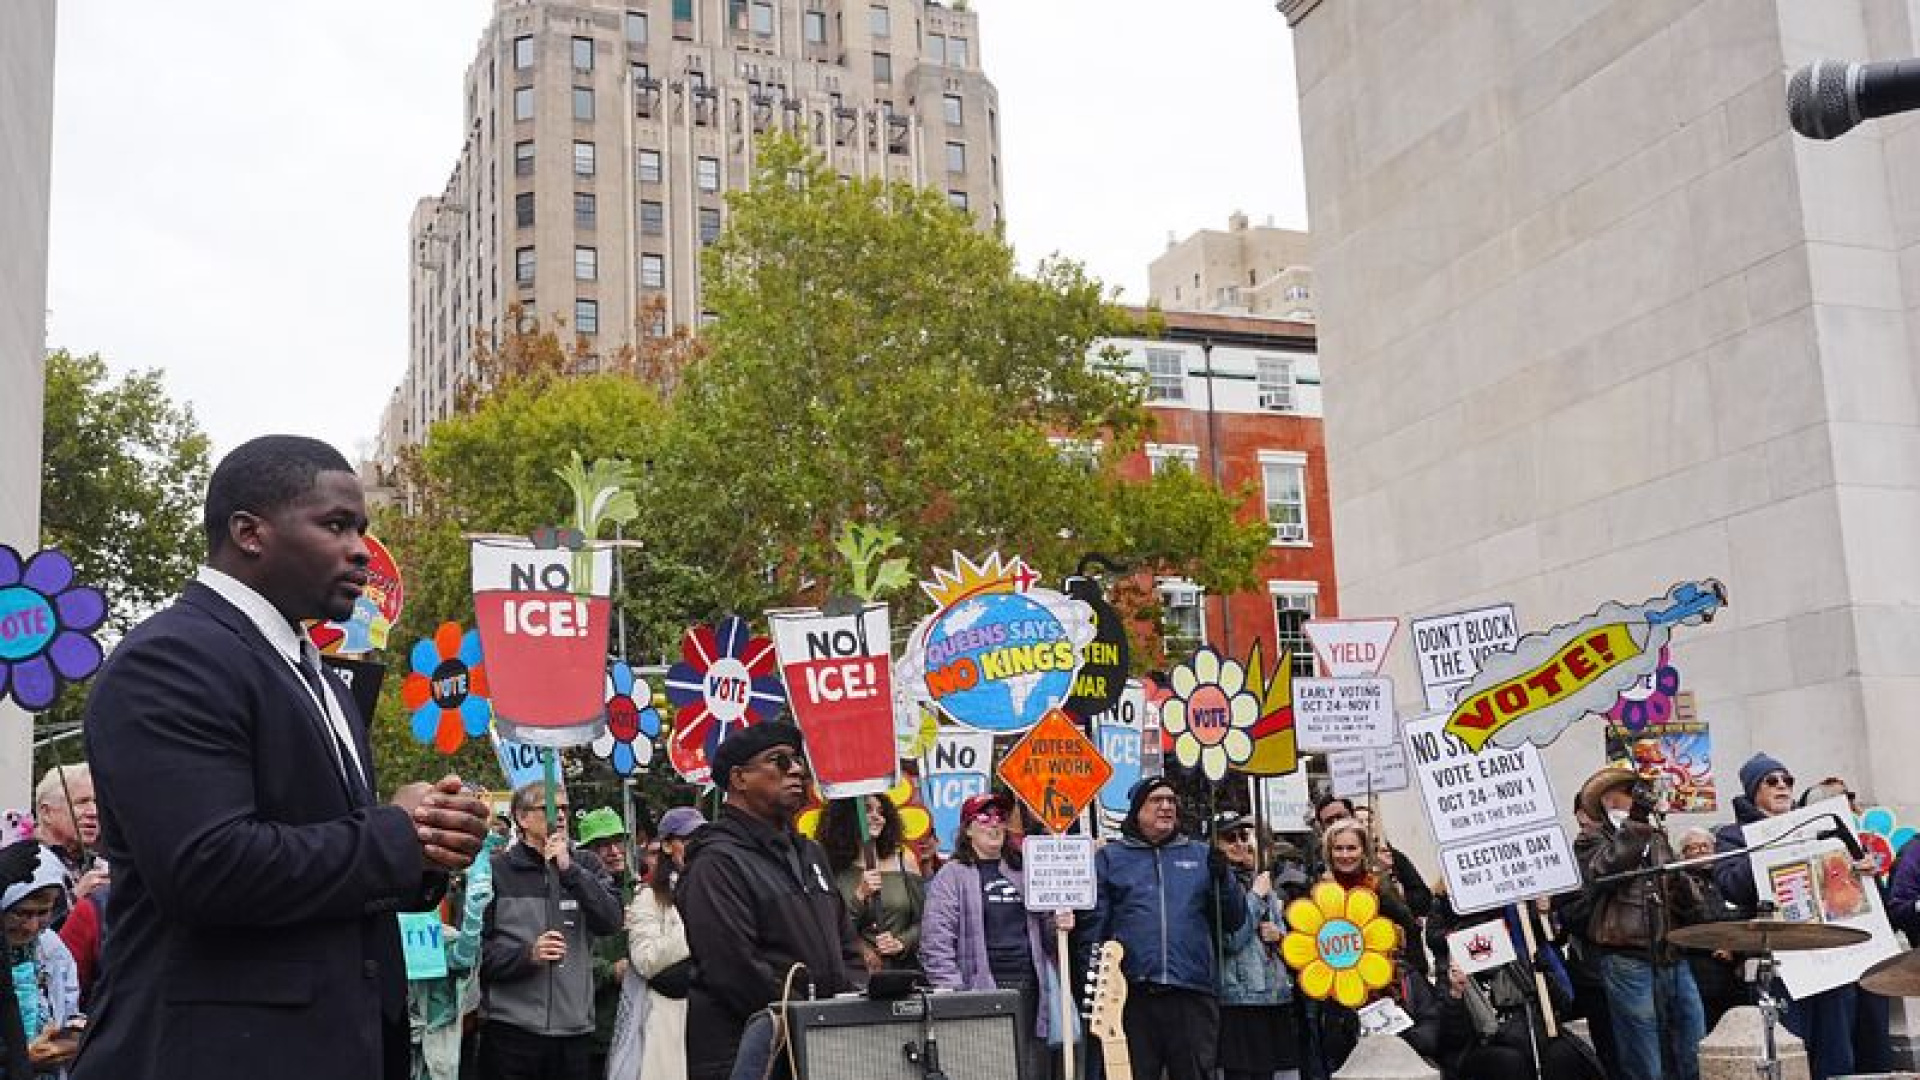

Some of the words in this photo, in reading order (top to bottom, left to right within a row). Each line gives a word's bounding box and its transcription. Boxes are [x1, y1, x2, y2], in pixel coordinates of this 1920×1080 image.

[510, 563, 570, 591] NO
[0, 607, 48, 641] OTE
[503, 599, 589, 637] ICE!
[1418, 622, 1462, 653] DON'T
[1465, 613, 1514, 643] BLOCK
[928, 622, 1006, 663] QUEENS
[1009, 619, 1061, 641] SAYS
[1329, 642, 1376, 663] YIELD
[925, 657, 980, 700] NO
[978, 641, 1076, 682] KINGS
[1430, 649, 1465, 677] THE
[432, 674, 467, 700] VOTE
[710, 676, 747, 703] VOTE
[805, 661, 878, 704] ICE!
[1300, 686, 1334, 699] EARLY
[1339, 685, 1381, 698] VOTING
[1453, 632, 1615, 731] VOTE!
[1193, 707, 1228, 728] VOTE
[1411, 731, 1442, 764] NO
[1024, 758, 1041, 774] AT
[1047, 758, 1093, 775] WORK
[1432, 762, 1474, 788] VOTE
[1478, 750, 1525, 779] EARLY
[1457, 842, 1522, 870] ELECTION
[1526, 834, 1551, 855] DAY
[1319, 933, 1360, 955] VOTE
